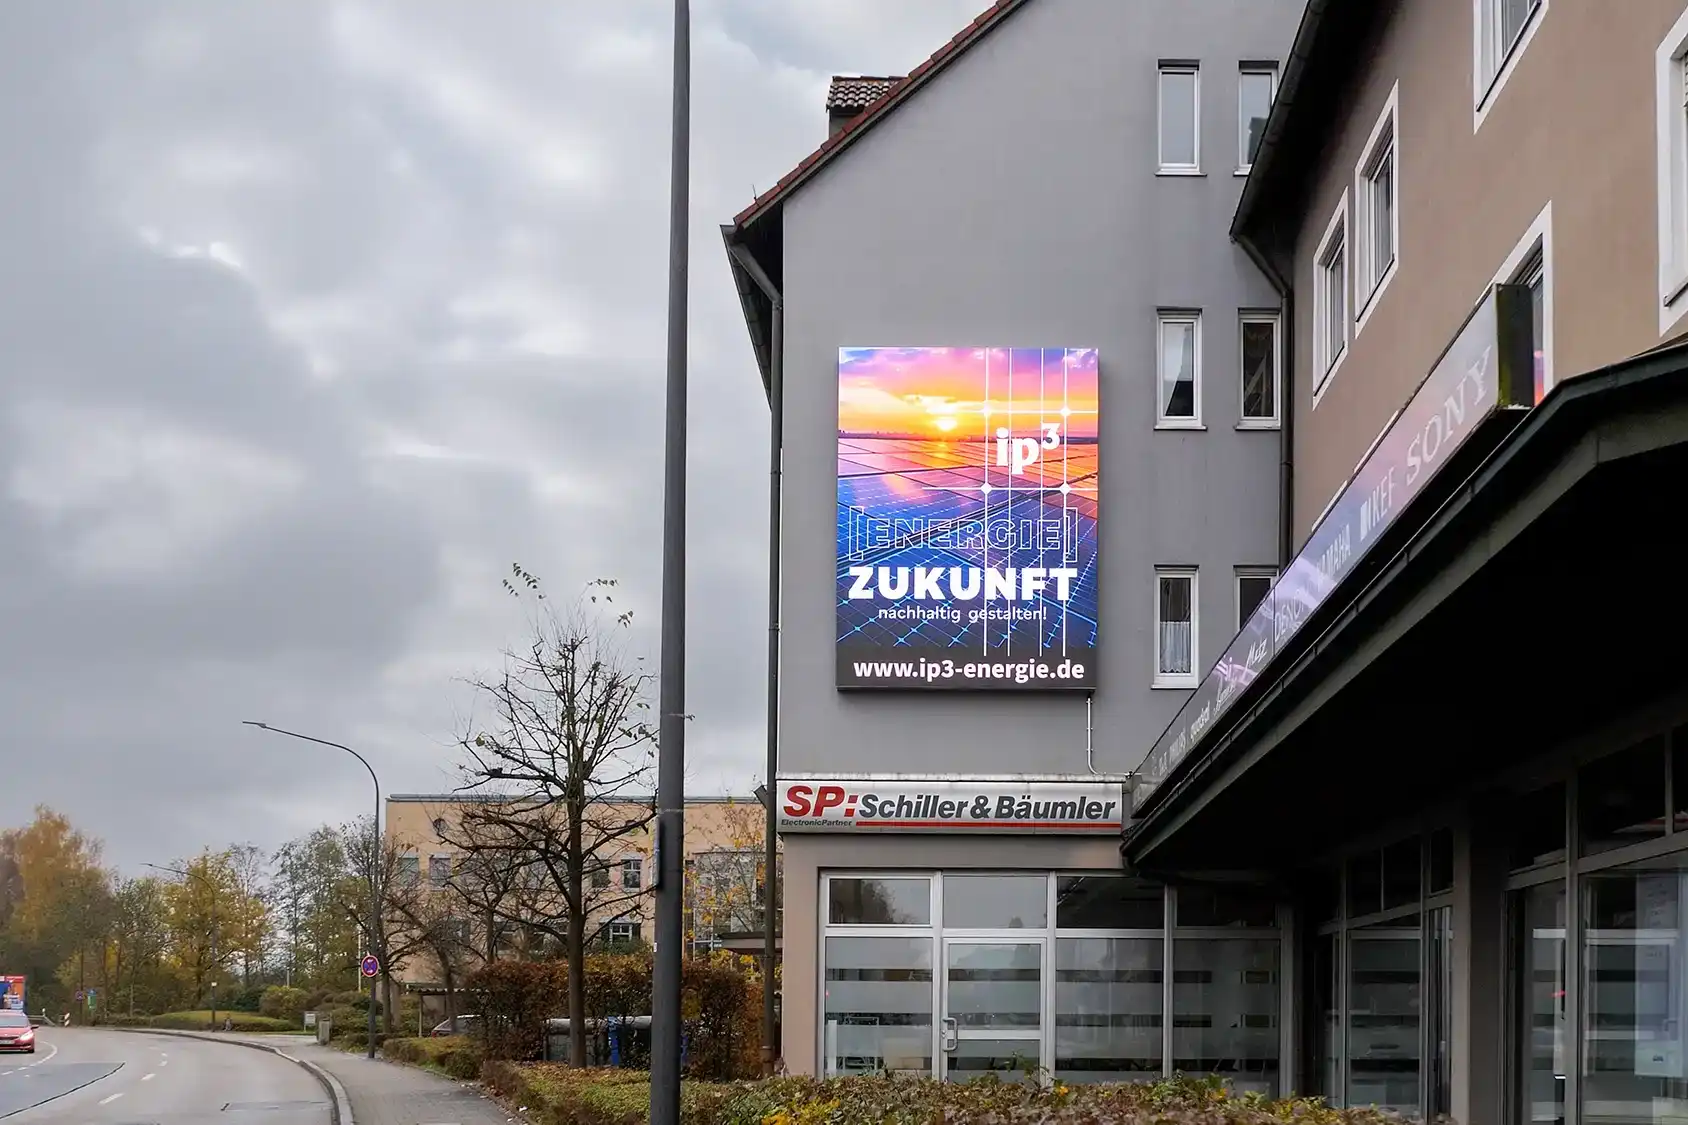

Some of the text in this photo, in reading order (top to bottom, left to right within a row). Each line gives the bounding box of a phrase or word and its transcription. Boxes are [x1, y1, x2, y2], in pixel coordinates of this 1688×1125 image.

[1405, 344, 1492, 487] SONY
[848, 567, 1078, 601] ZUKUNFT
[878, 606, 1047, 622] nachhaltig gestalten!
[853, 657, 1085, 684] www.ip3-energie.de
[783, 785, 859, 818] SP:
[859, 794, 968, 819] Schiller
[994, 795, 1116, 820] Bäumler
[780, 819, 852, 827] ElectronicPartner
